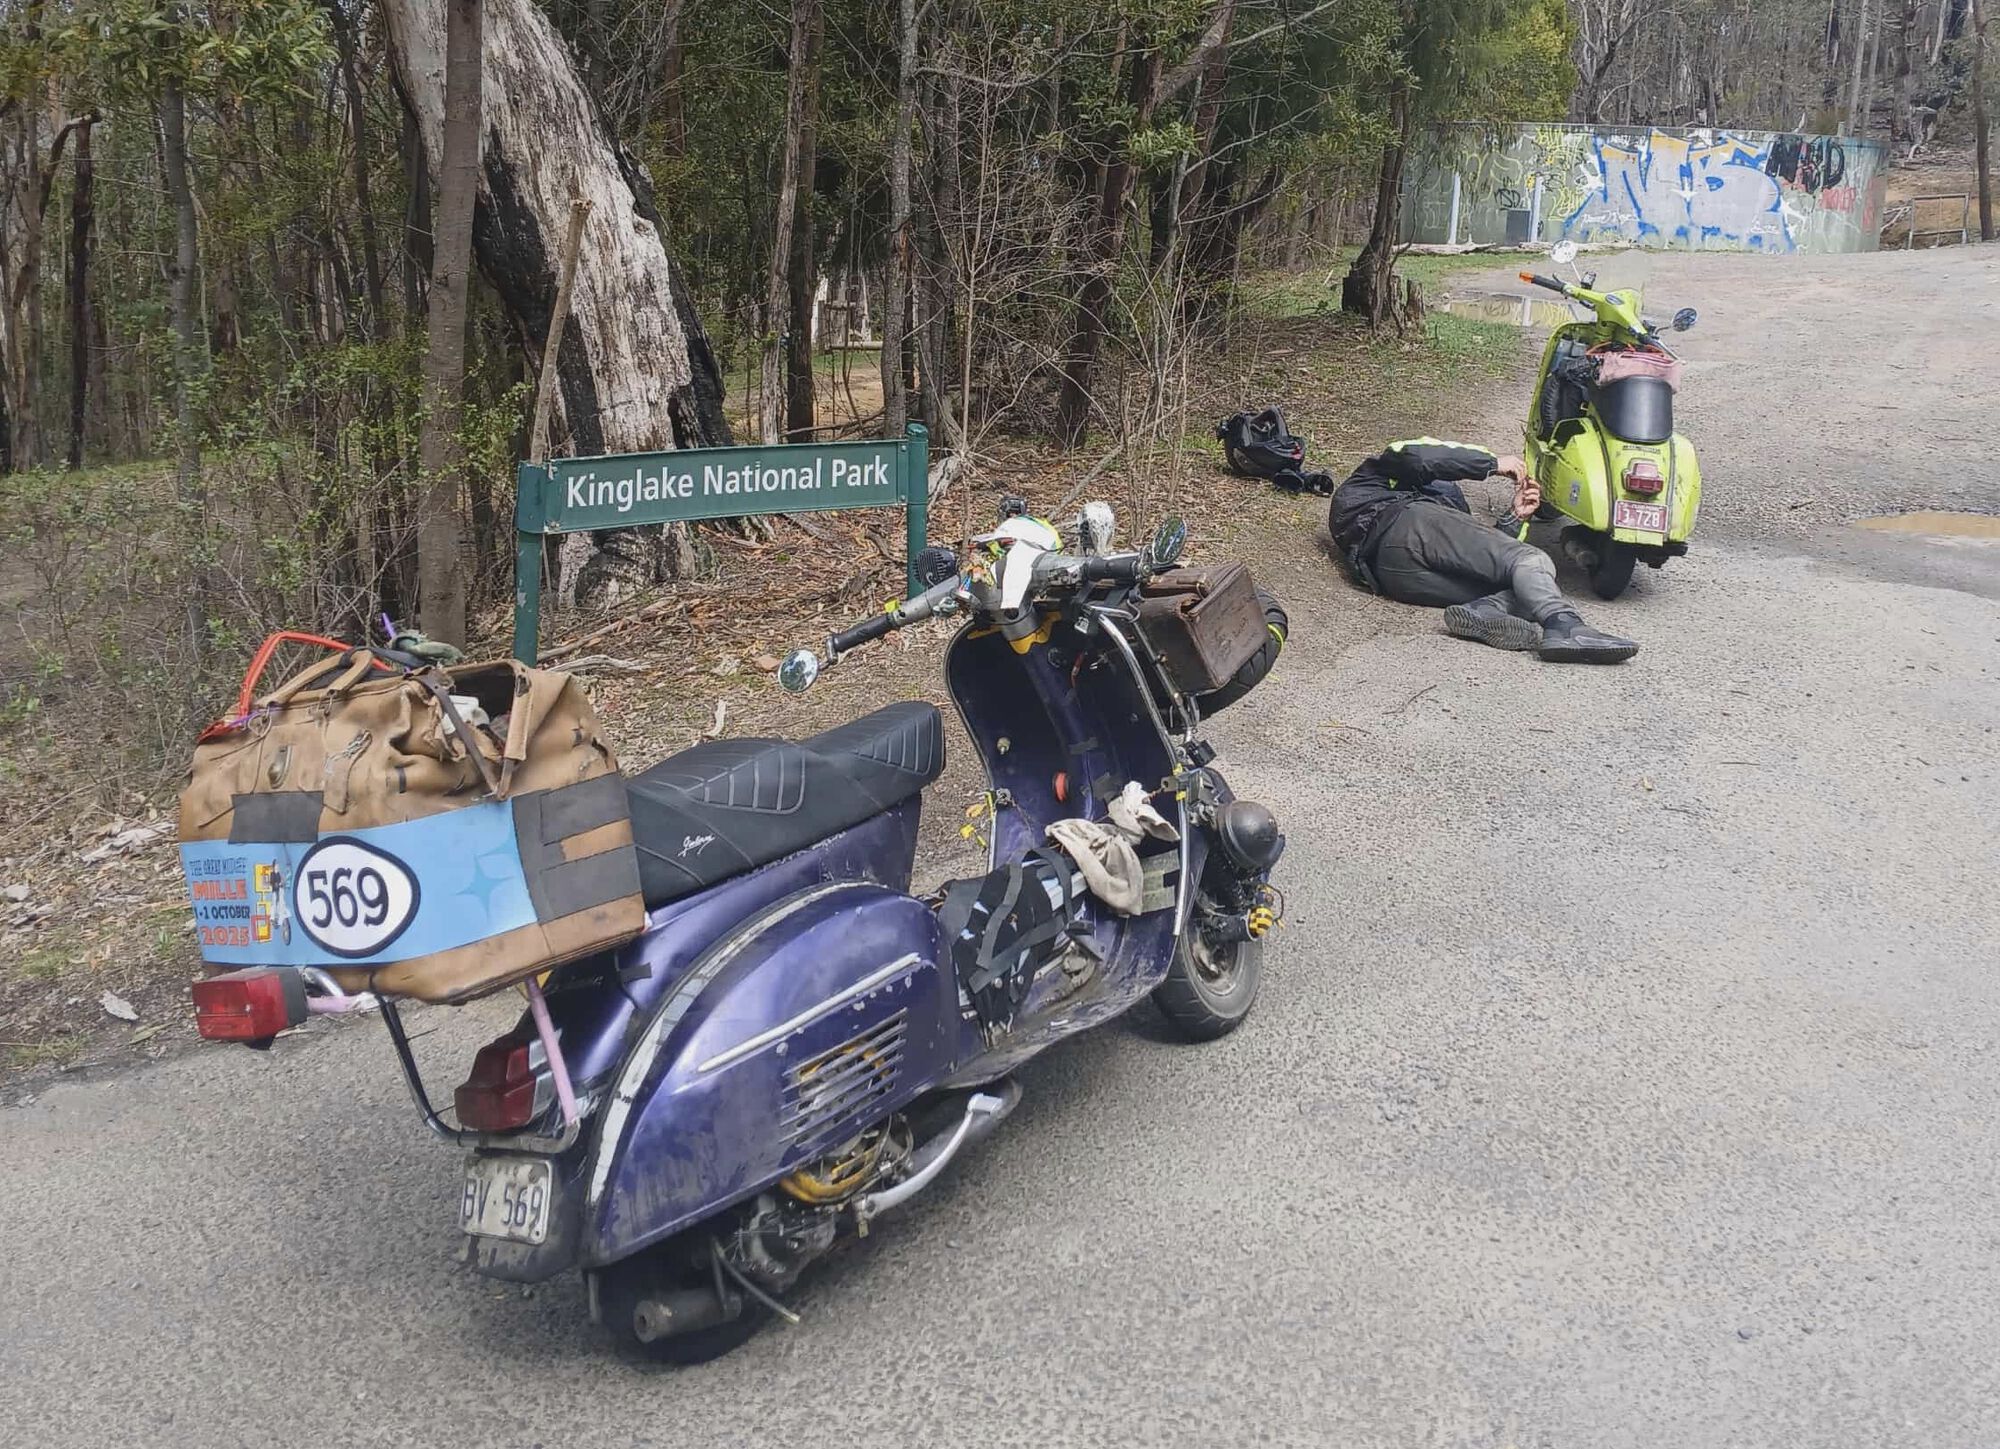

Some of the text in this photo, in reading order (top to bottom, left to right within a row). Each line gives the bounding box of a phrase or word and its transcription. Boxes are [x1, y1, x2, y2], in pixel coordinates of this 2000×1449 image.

[566, 455, 889, 512] Kinglake National Park
[192, 879, 248, 900] MILLE
[306, 866, 390, 929] 569
[211, 904, 251, 919] OCTOBER
[201, 926, 249, 946] 2025
